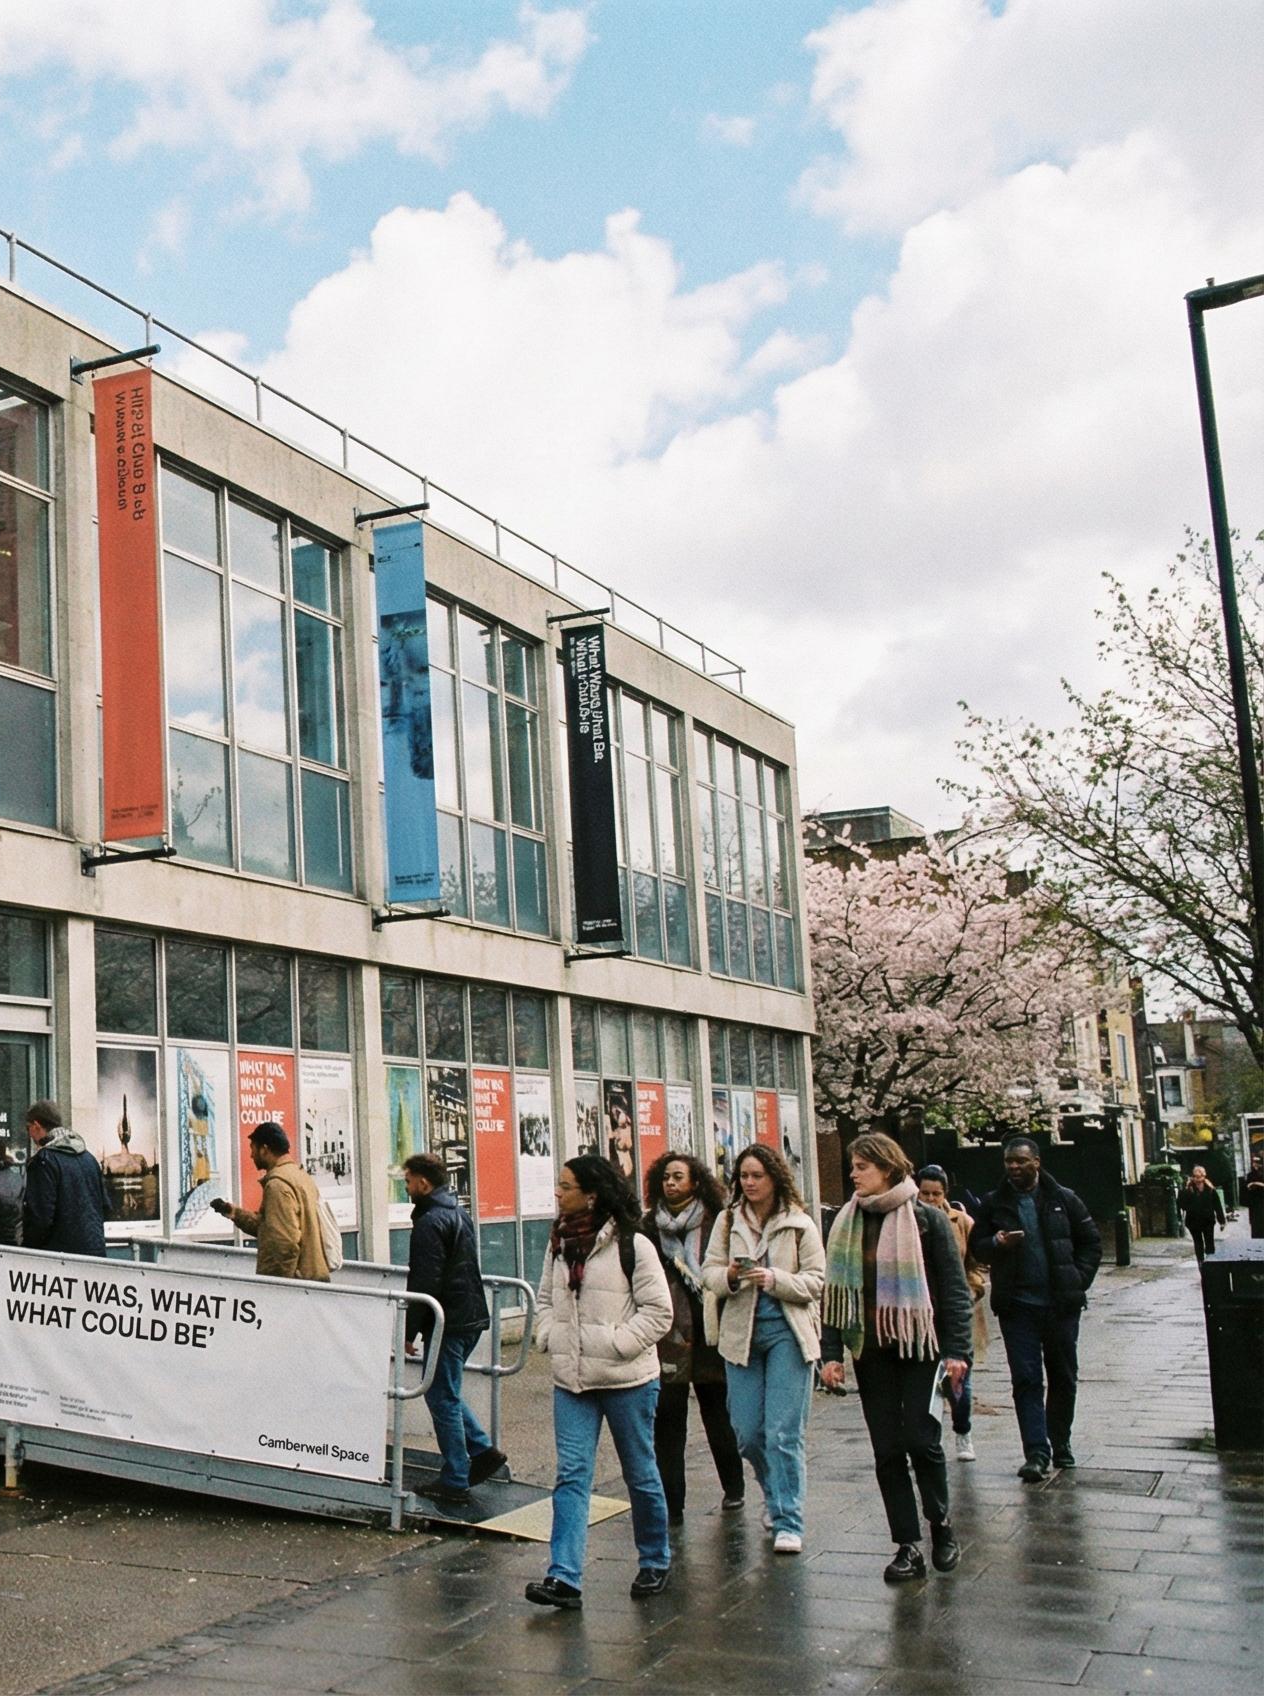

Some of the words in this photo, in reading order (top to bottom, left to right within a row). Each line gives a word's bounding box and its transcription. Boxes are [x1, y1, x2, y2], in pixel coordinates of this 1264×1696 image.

[6, 1299, 76, 1329] WHAT
[82, 1310, 168, 1342] COULD
[9, 1270, 78, 1300] WHAT
[84, 1280, 143, 1313] WAS,
[151, 1288, 226, 1319] WHAT
[233, 1298, 262, 1330] IS,
[331, 1445, 369, 1462] Space
